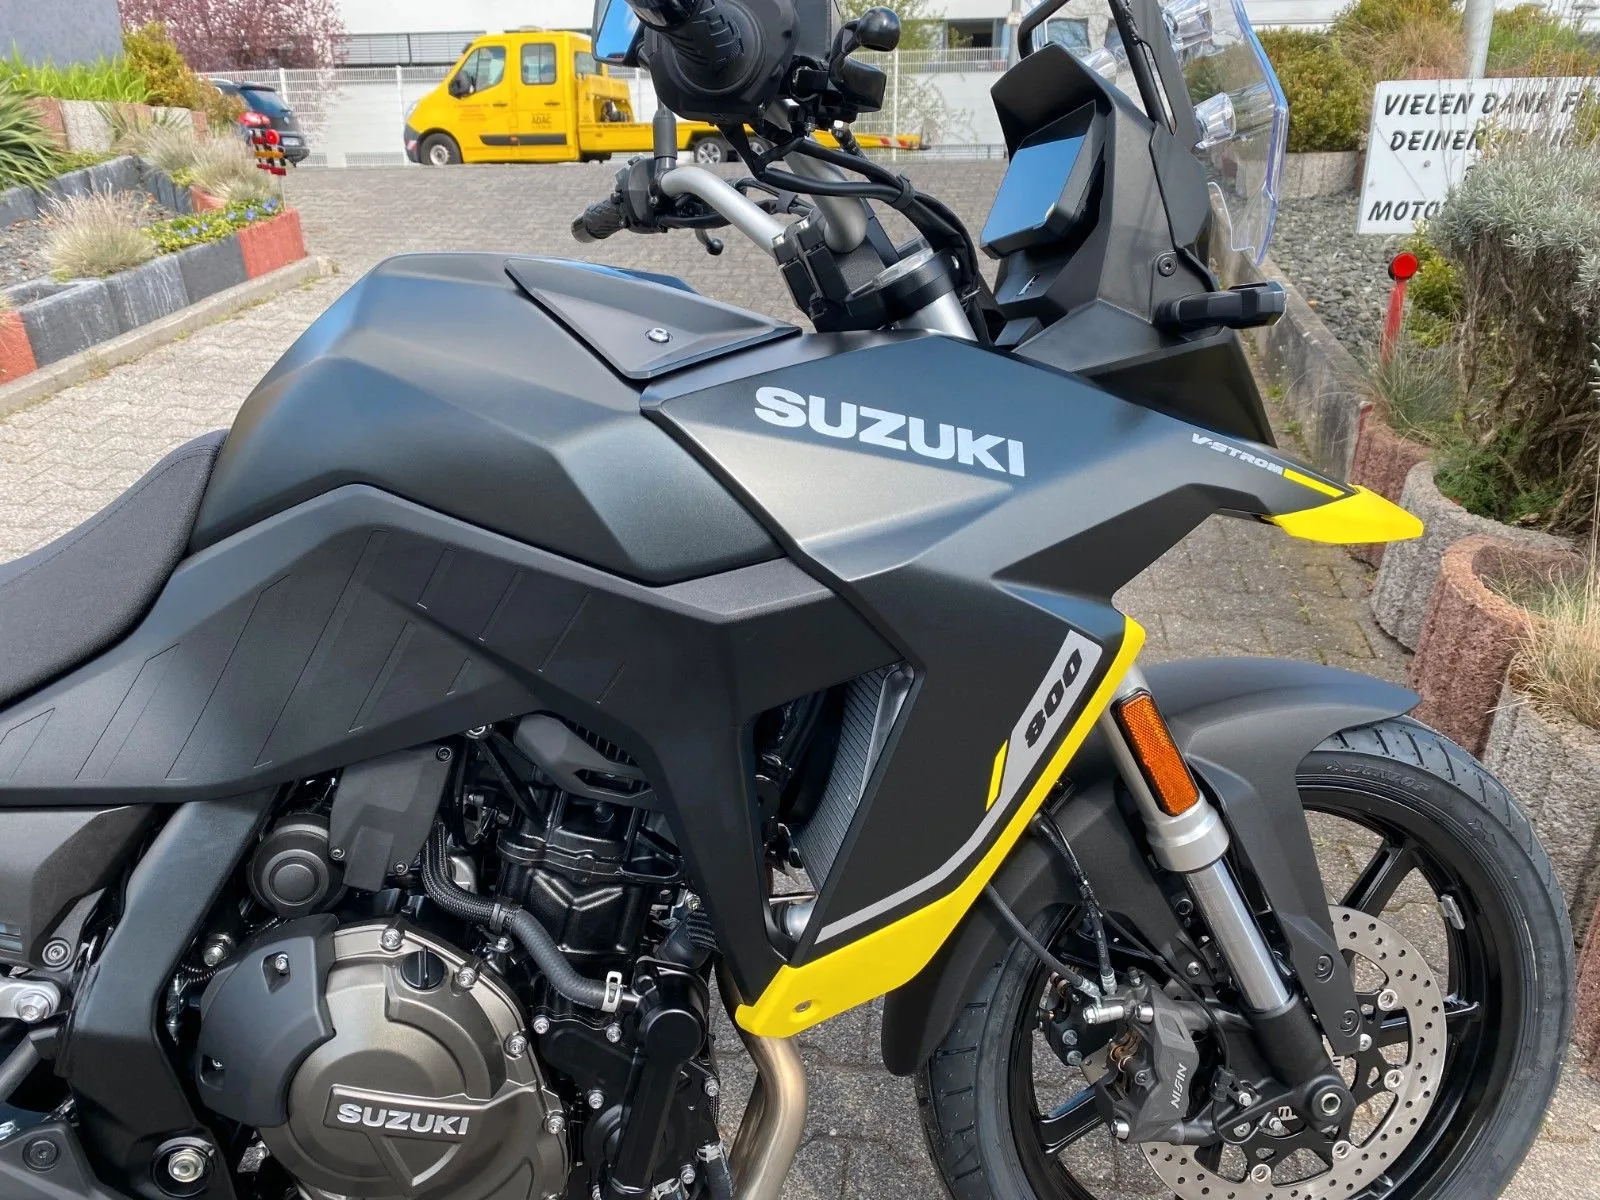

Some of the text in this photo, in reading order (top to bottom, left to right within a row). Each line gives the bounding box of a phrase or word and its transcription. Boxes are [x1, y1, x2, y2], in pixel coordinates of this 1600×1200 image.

[1384, 92, 1475, 115] VIELEN
[1368, 200, 1447, 221] MOTO
[755, 386, 1025, 477] SUZUKI
[1191, 432, 1284, 476] V-STROM
[1024, 648, 1083, 749] 800
[1170, 1062, 1188, 1109] NISSIN
[336, 1103, 470, 1135] SUZUKI
